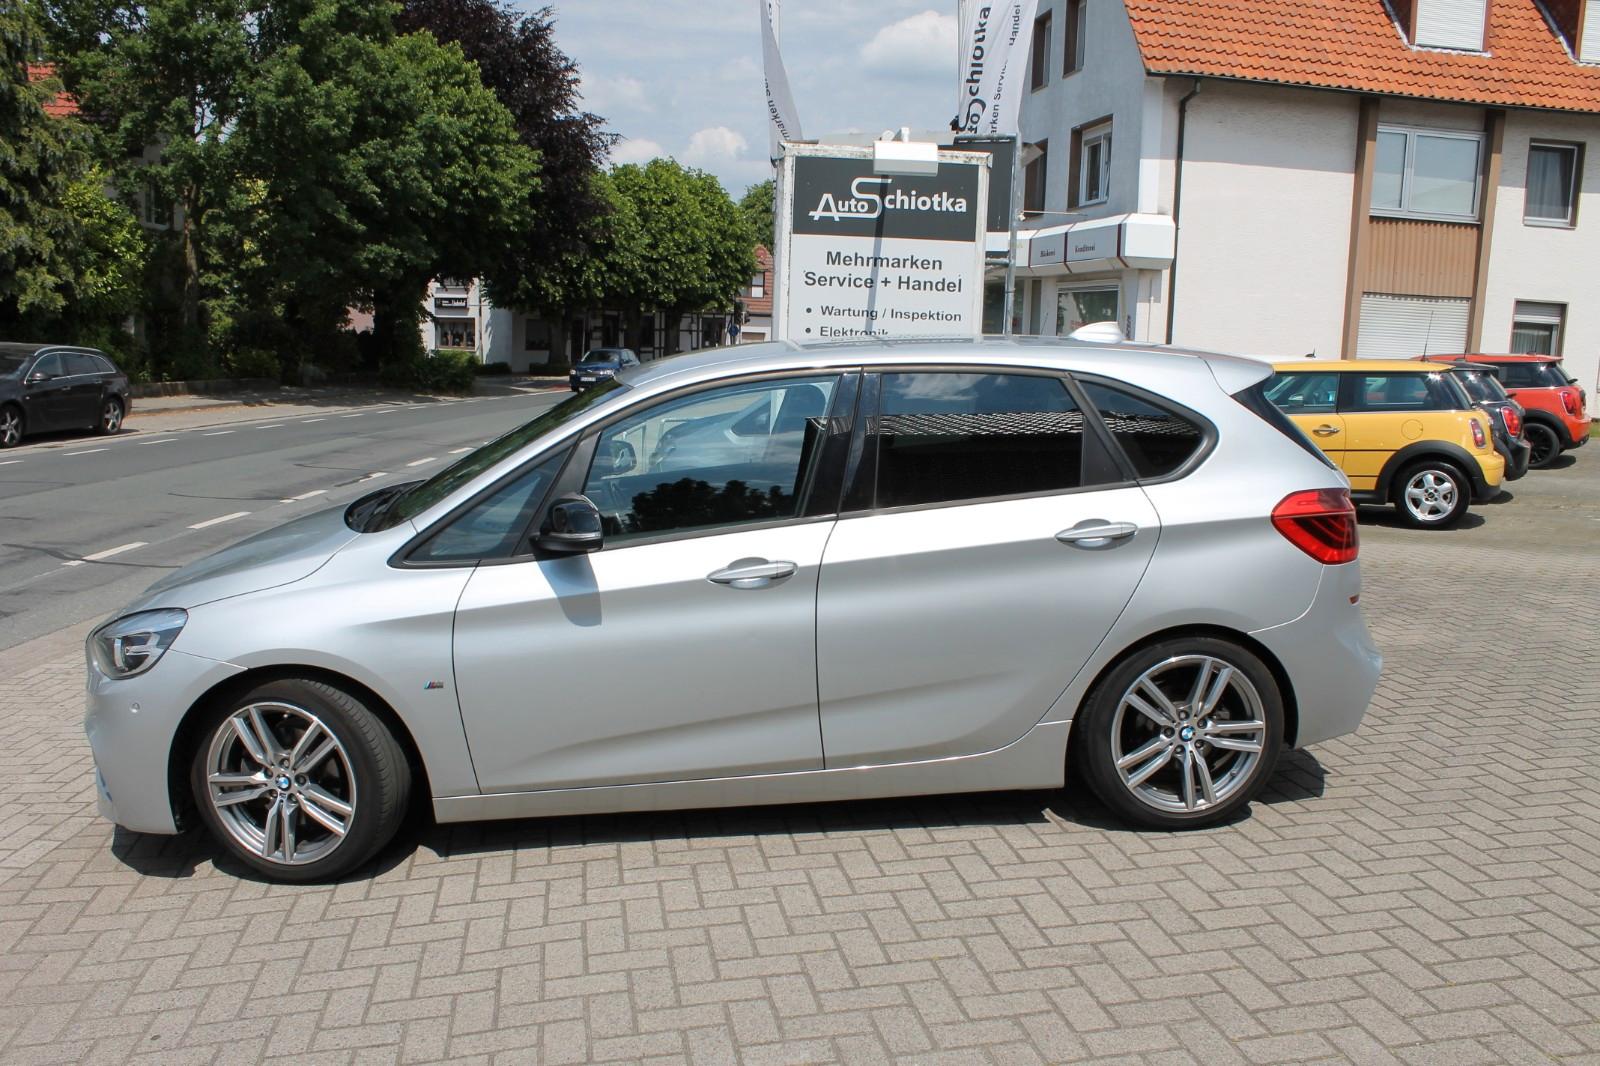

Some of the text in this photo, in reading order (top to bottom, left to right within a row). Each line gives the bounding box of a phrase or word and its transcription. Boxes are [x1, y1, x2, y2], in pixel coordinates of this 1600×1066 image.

[826, 251, 943, 270] Mehrmarken
[804, 272, 963, 293] Service + Handel
[820, 306, 878, 319] Wartung
[890, 309, 962, 322] Inspektion
